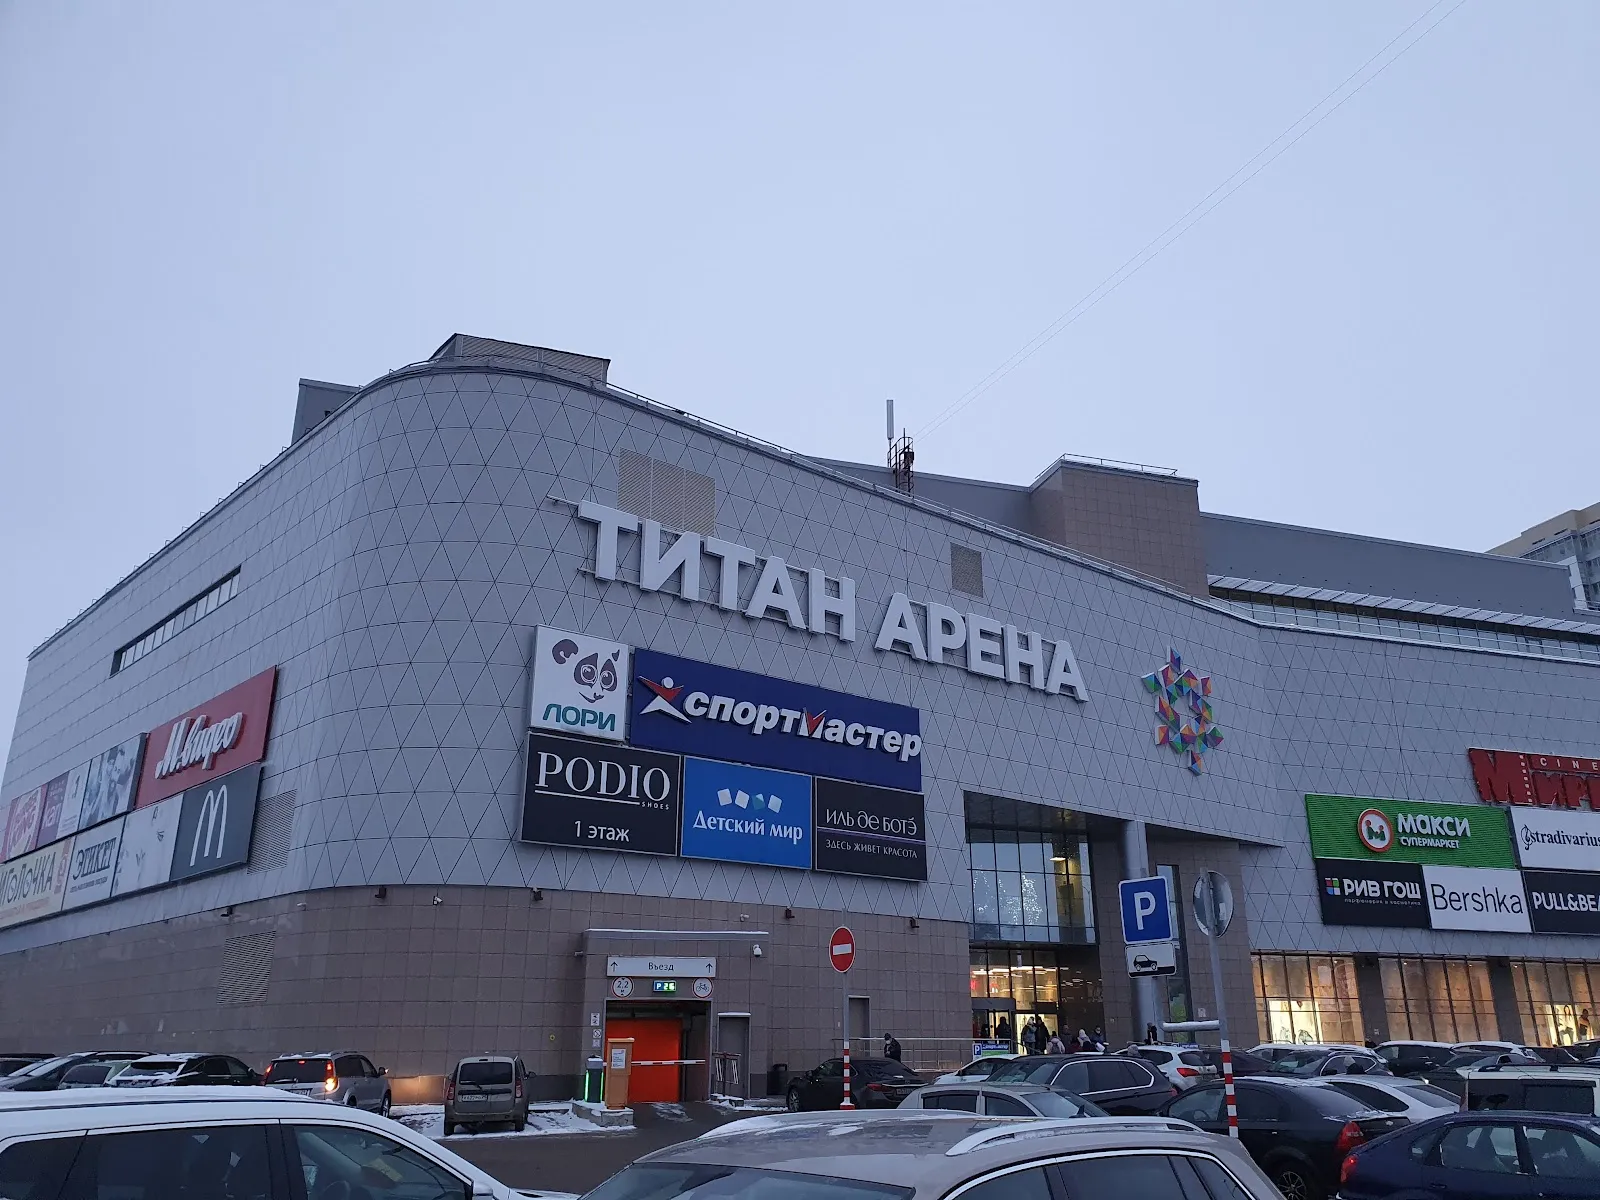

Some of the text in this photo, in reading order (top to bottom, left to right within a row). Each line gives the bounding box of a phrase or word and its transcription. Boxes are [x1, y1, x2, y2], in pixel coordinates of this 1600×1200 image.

[577, 500, 1090, 702] ТИТАН АРЕНА
[543, 703, 616, 732] ЛОРИ
[534, 751, 671, 801] PODIO
[641, 801, 670, 811] SHOES
[574, 820, 630, 842] 1 этаж
[692, 810, 803, 844] Детский мир
[825, 838, 918, 859] ЗДЕСЬ ЖИВЕТ КРАСОТА
[1400, 836, 1460, 849] СУПЕРМАРКЕТ
[1342, 878, 1421, 899] РИВ ГОШ
[1430, 883, 1523, 915] Bershka
[1133, 891, 1156, 930] P
[1532, 891, 1600, 912] PULL&BE
[648, 962, 675, 971] Въезд
